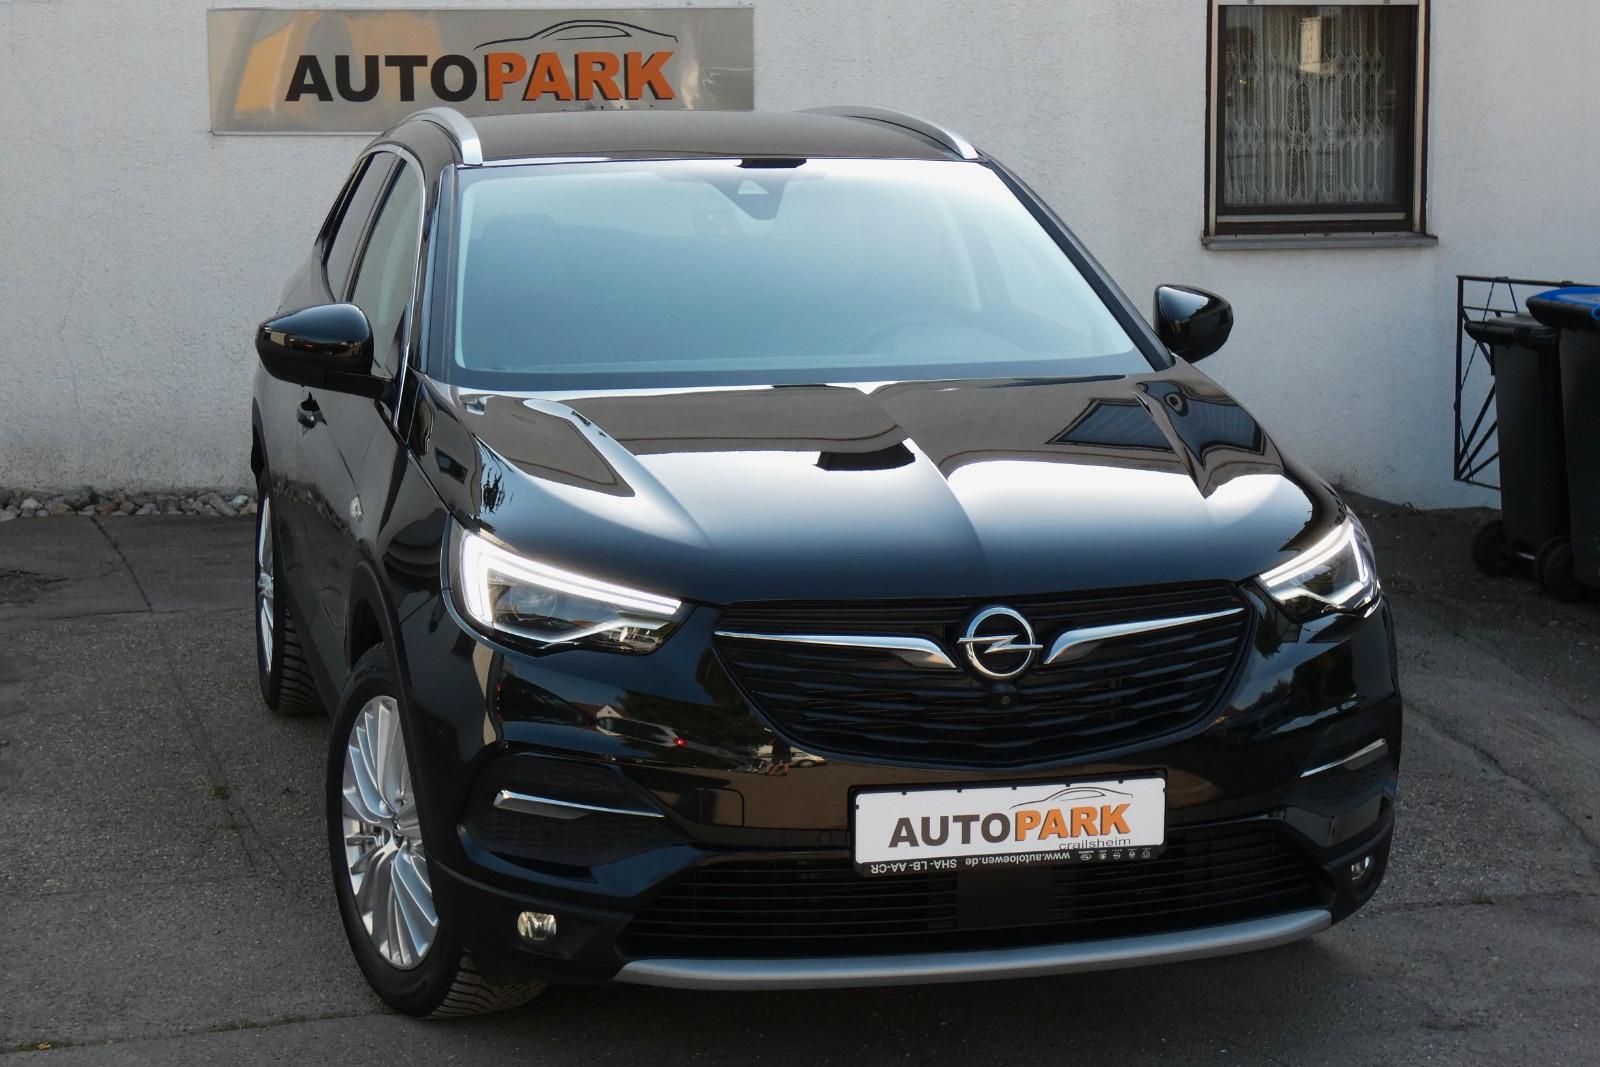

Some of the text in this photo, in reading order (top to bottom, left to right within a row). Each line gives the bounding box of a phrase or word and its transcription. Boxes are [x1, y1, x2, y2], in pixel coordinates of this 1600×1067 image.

[286, 51, 676, 102] AUTOPARK
[888, 803, 1132, 848] AUTOPARK
[1058, 837, 1131, 850] crailsheim
[965, 851, 1070, 867] www.autoloewen.de
